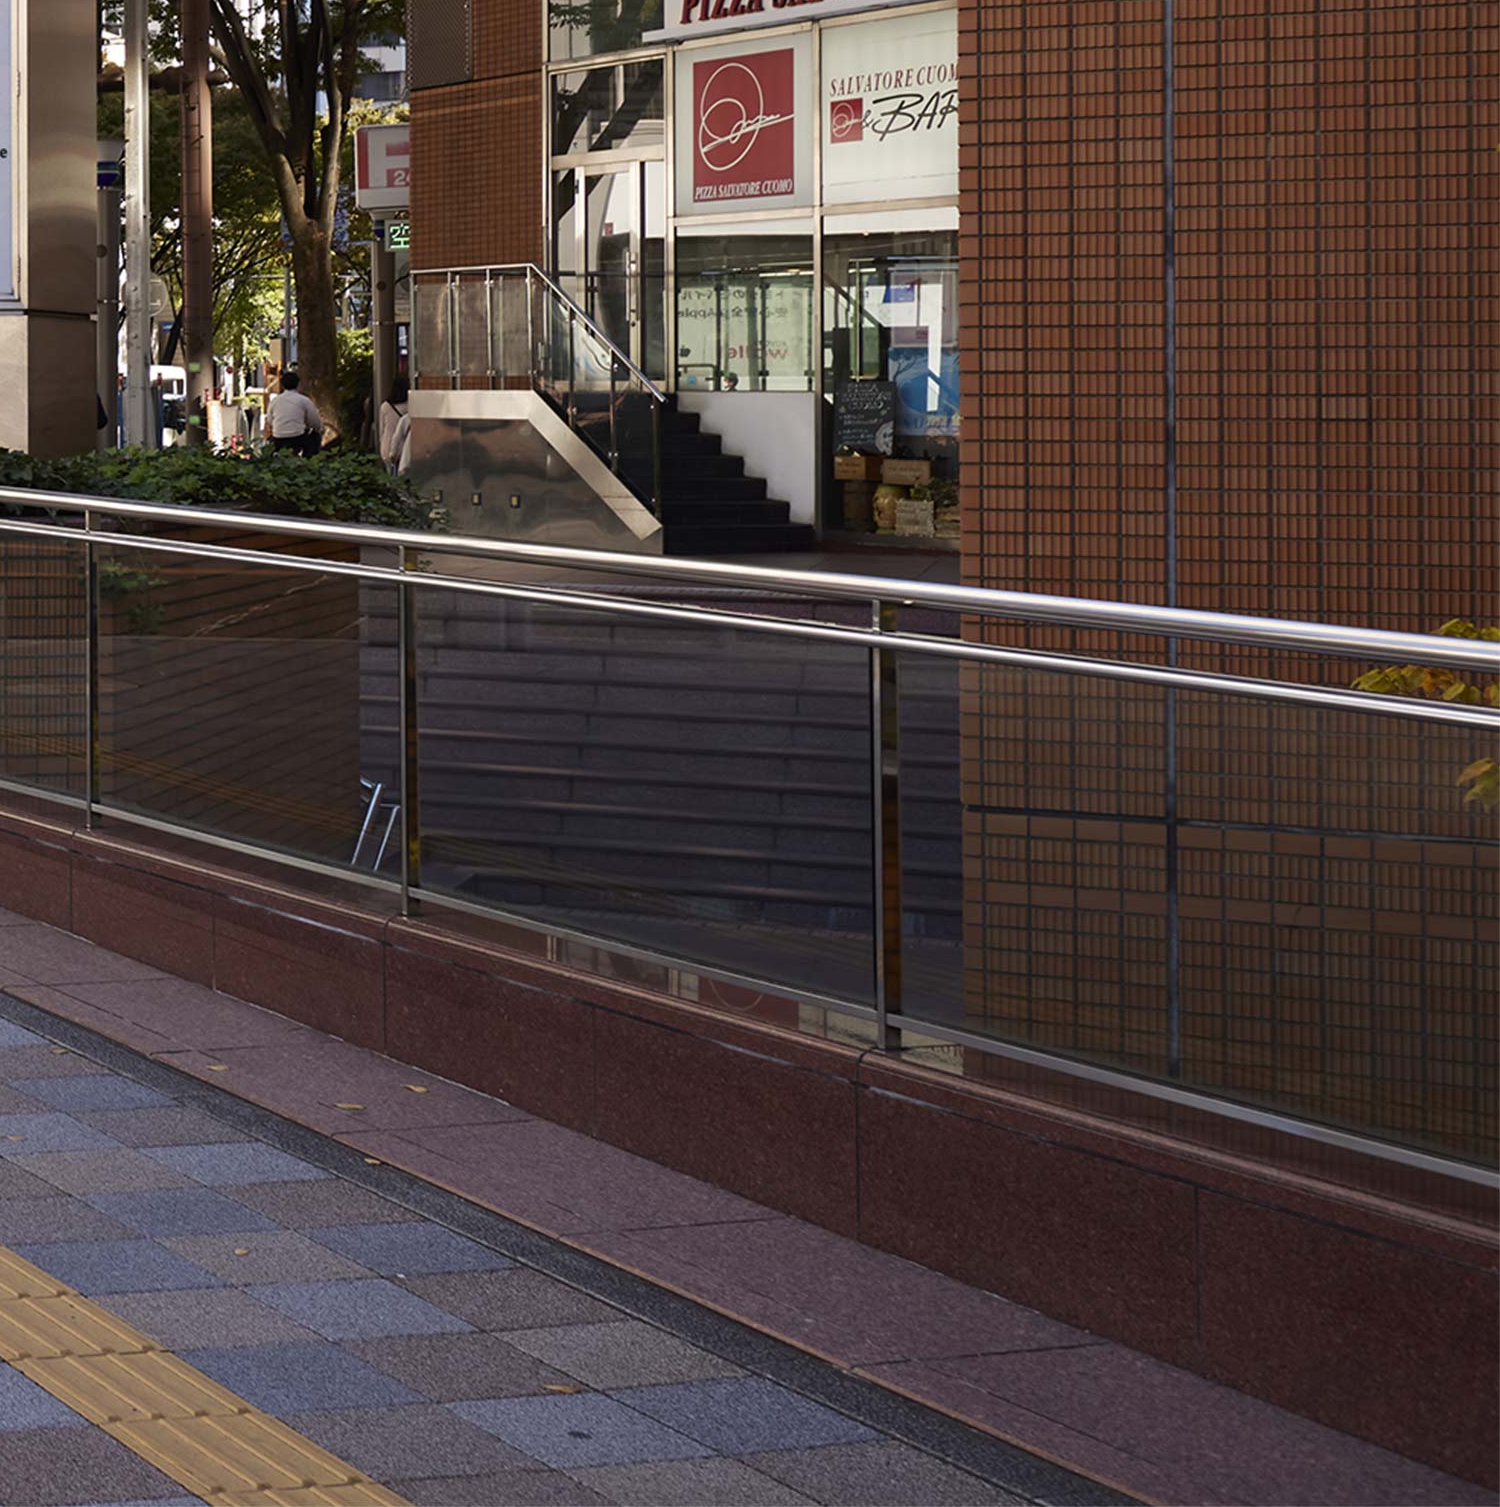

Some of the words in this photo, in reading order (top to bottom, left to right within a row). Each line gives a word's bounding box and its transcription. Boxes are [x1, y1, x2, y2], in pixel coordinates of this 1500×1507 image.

[829, 68, 914, 97] SALVATORE
[916, 62, 959, 86] CUOM
[862, 108, 874, 128] &
[694, 184, 717, 200] PIZZA
[717, 181, 760, 198] SALVATORE
[760, 178, 793, 195] CUOMO
